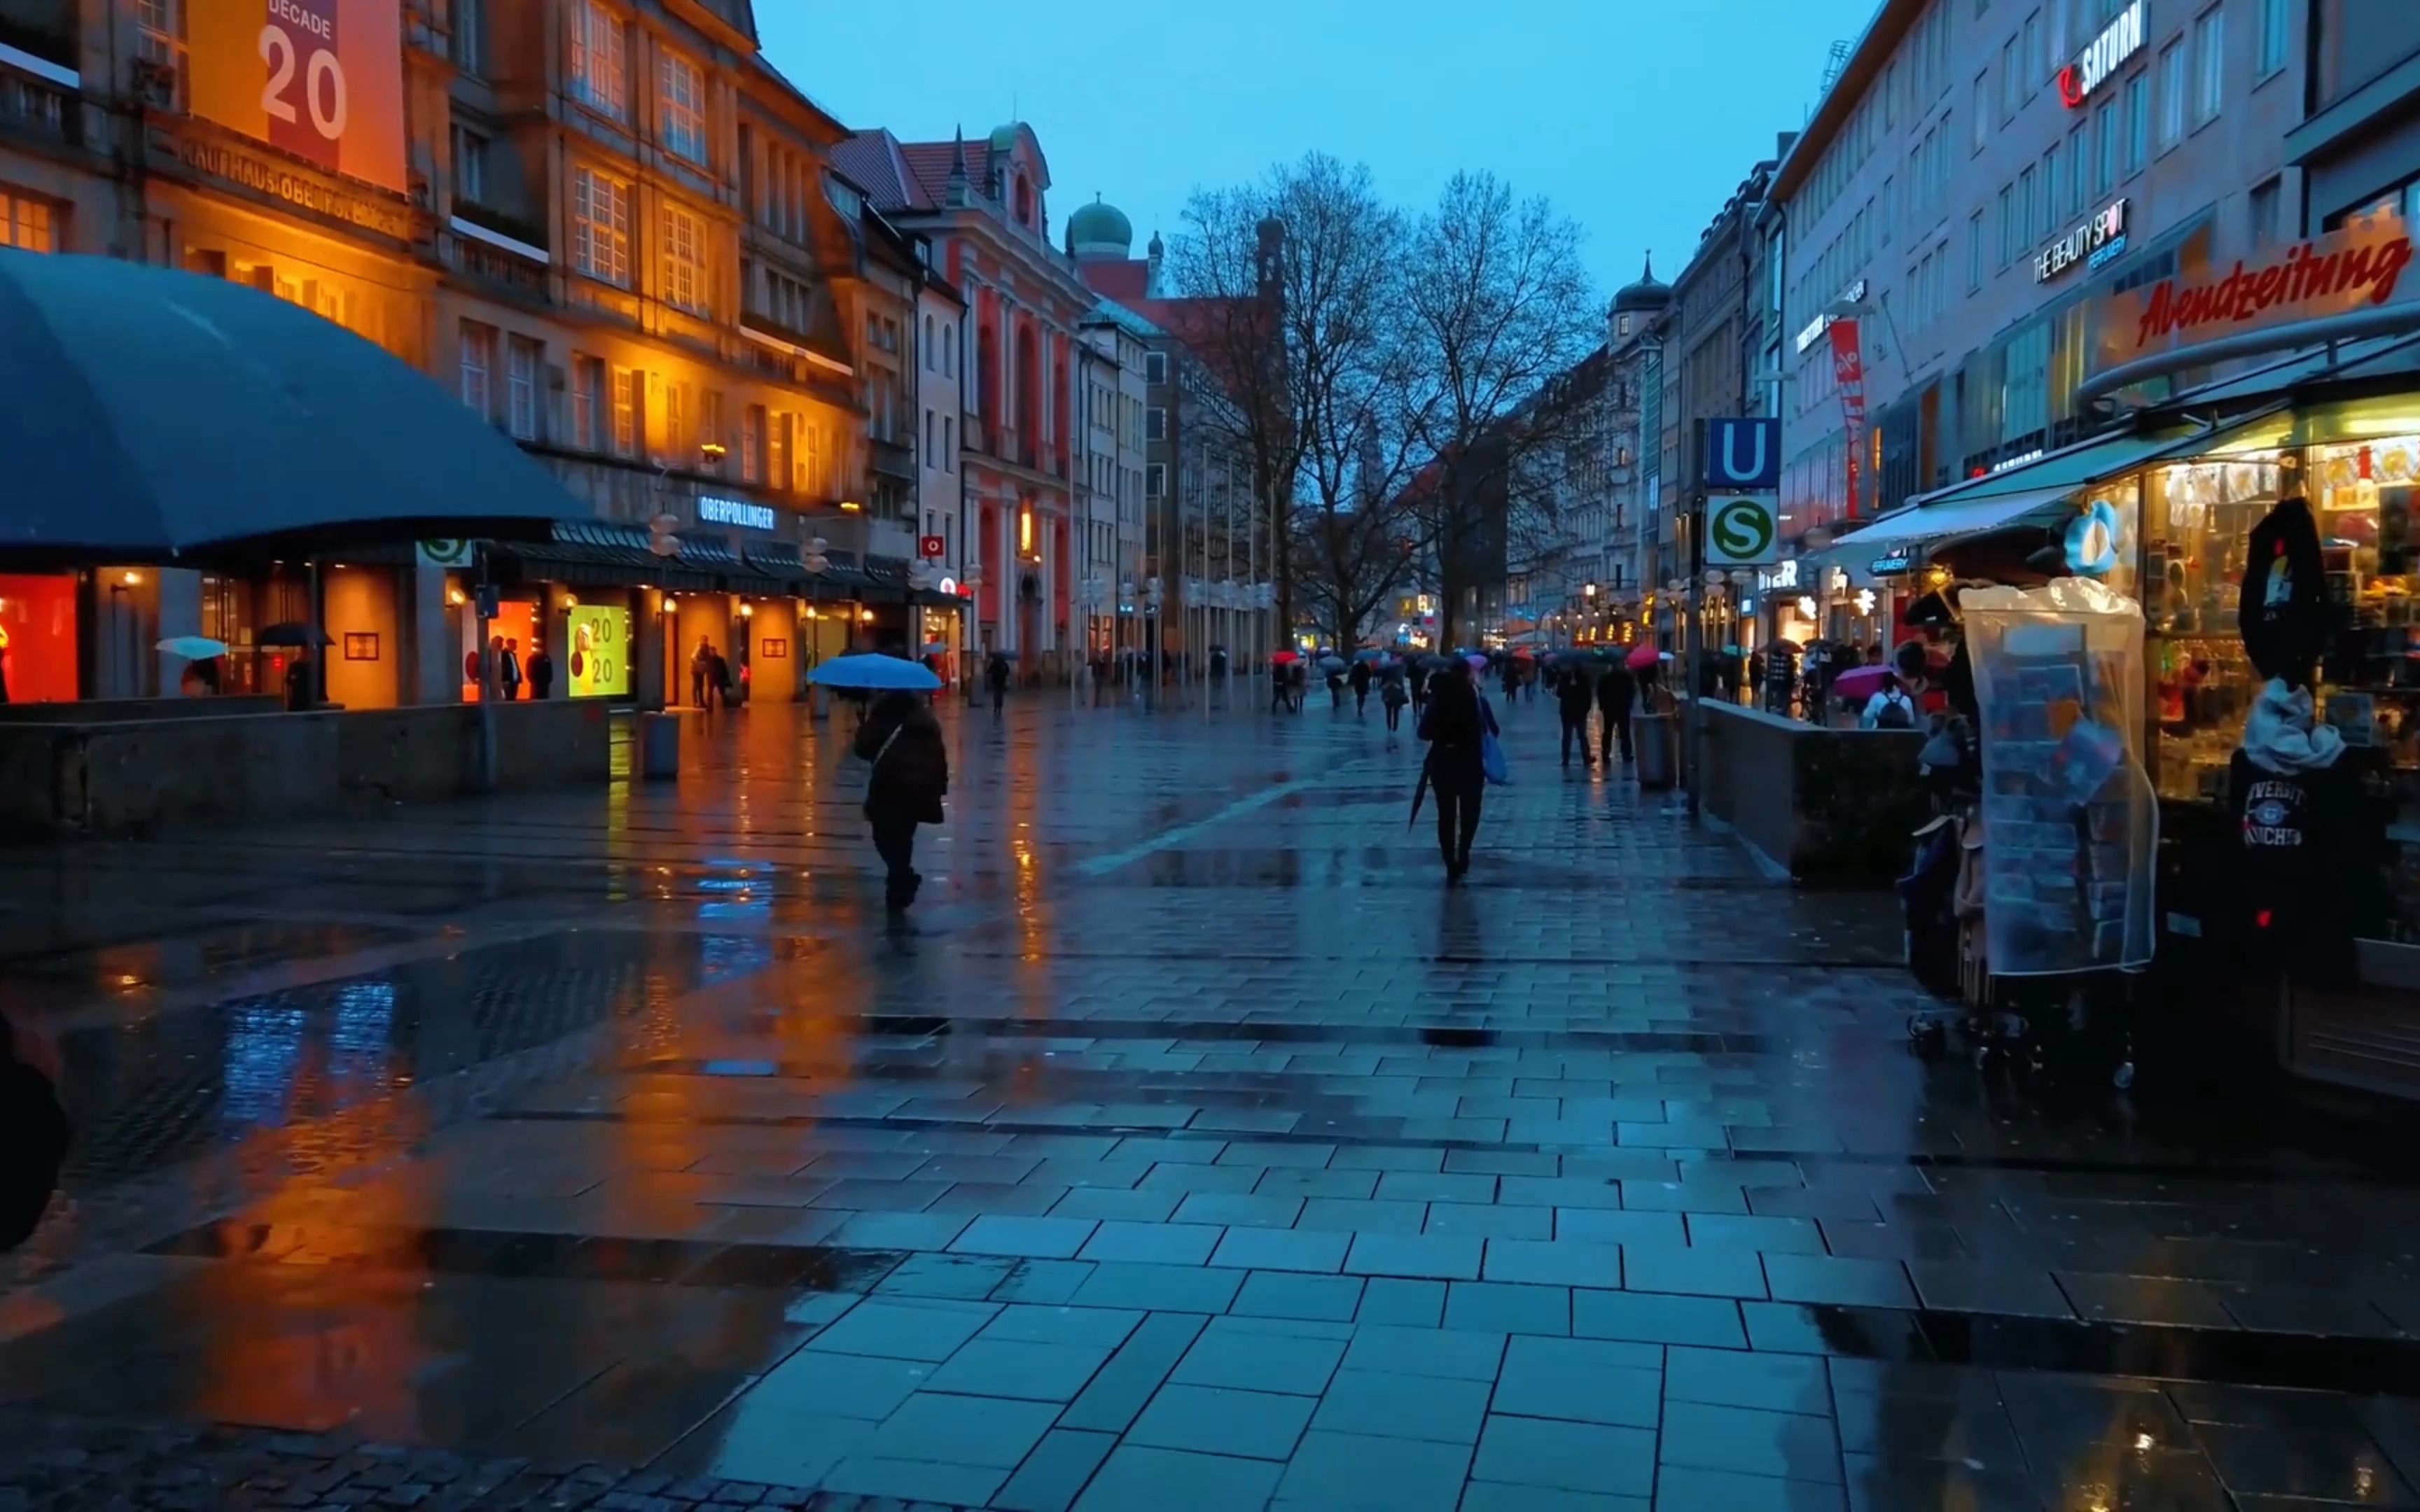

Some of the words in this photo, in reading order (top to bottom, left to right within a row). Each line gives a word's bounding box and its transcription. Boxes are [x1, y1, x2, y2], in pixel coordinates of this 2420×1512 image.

[269, 0, 331, 40] DECADE
[2082, 0, 2142, 95] SATURN
[258, 24, 347, 140] 20
[2033, 248, 2051, 284] THE
[2052, 220, 2094, 273] BEAUTY
[2136, 236, 2413, 347] Abendzeitung
[1723, 422, 1767, 481] U
[701, 496, 774, 530] OBERPOLLINGER
[1723, 507, 1762, 553] S
[592, 617, 612, 643] 20
[592, 658, 613, 683] 20
